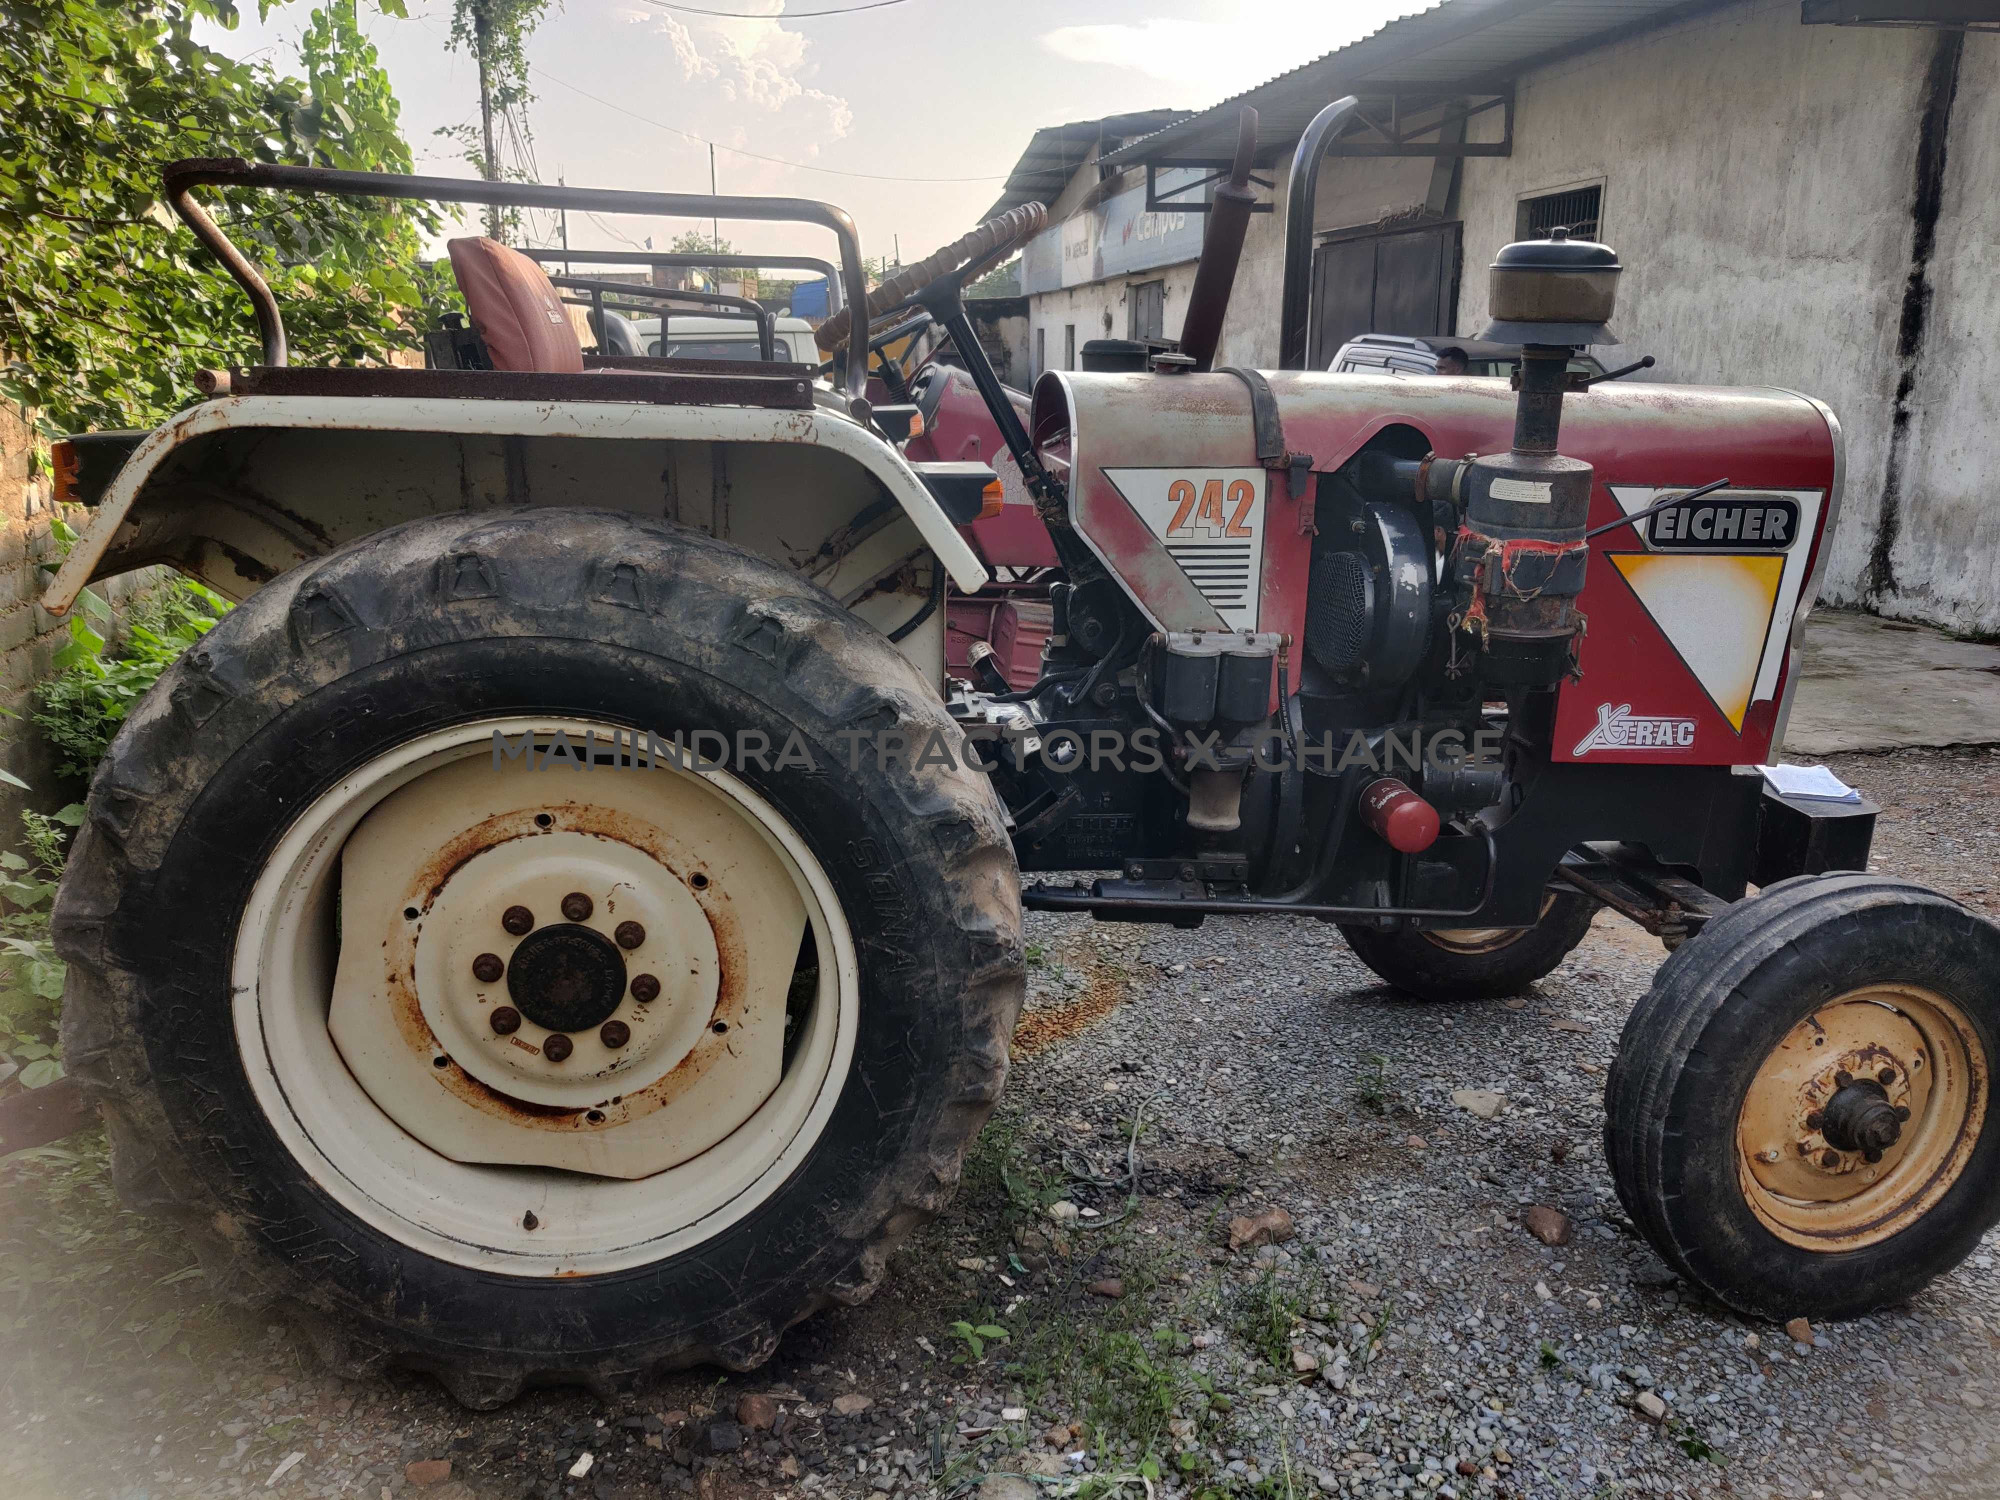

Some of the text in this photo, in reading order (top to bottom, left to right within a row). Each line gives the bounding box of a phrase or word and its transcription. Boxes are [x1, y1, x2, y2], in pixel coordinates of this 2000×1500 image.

[1166, 479, 1255, 538] 242
[1654, 507, 1788, 541] EICHER
[1572, 702, 1696, 757] XTRAC
